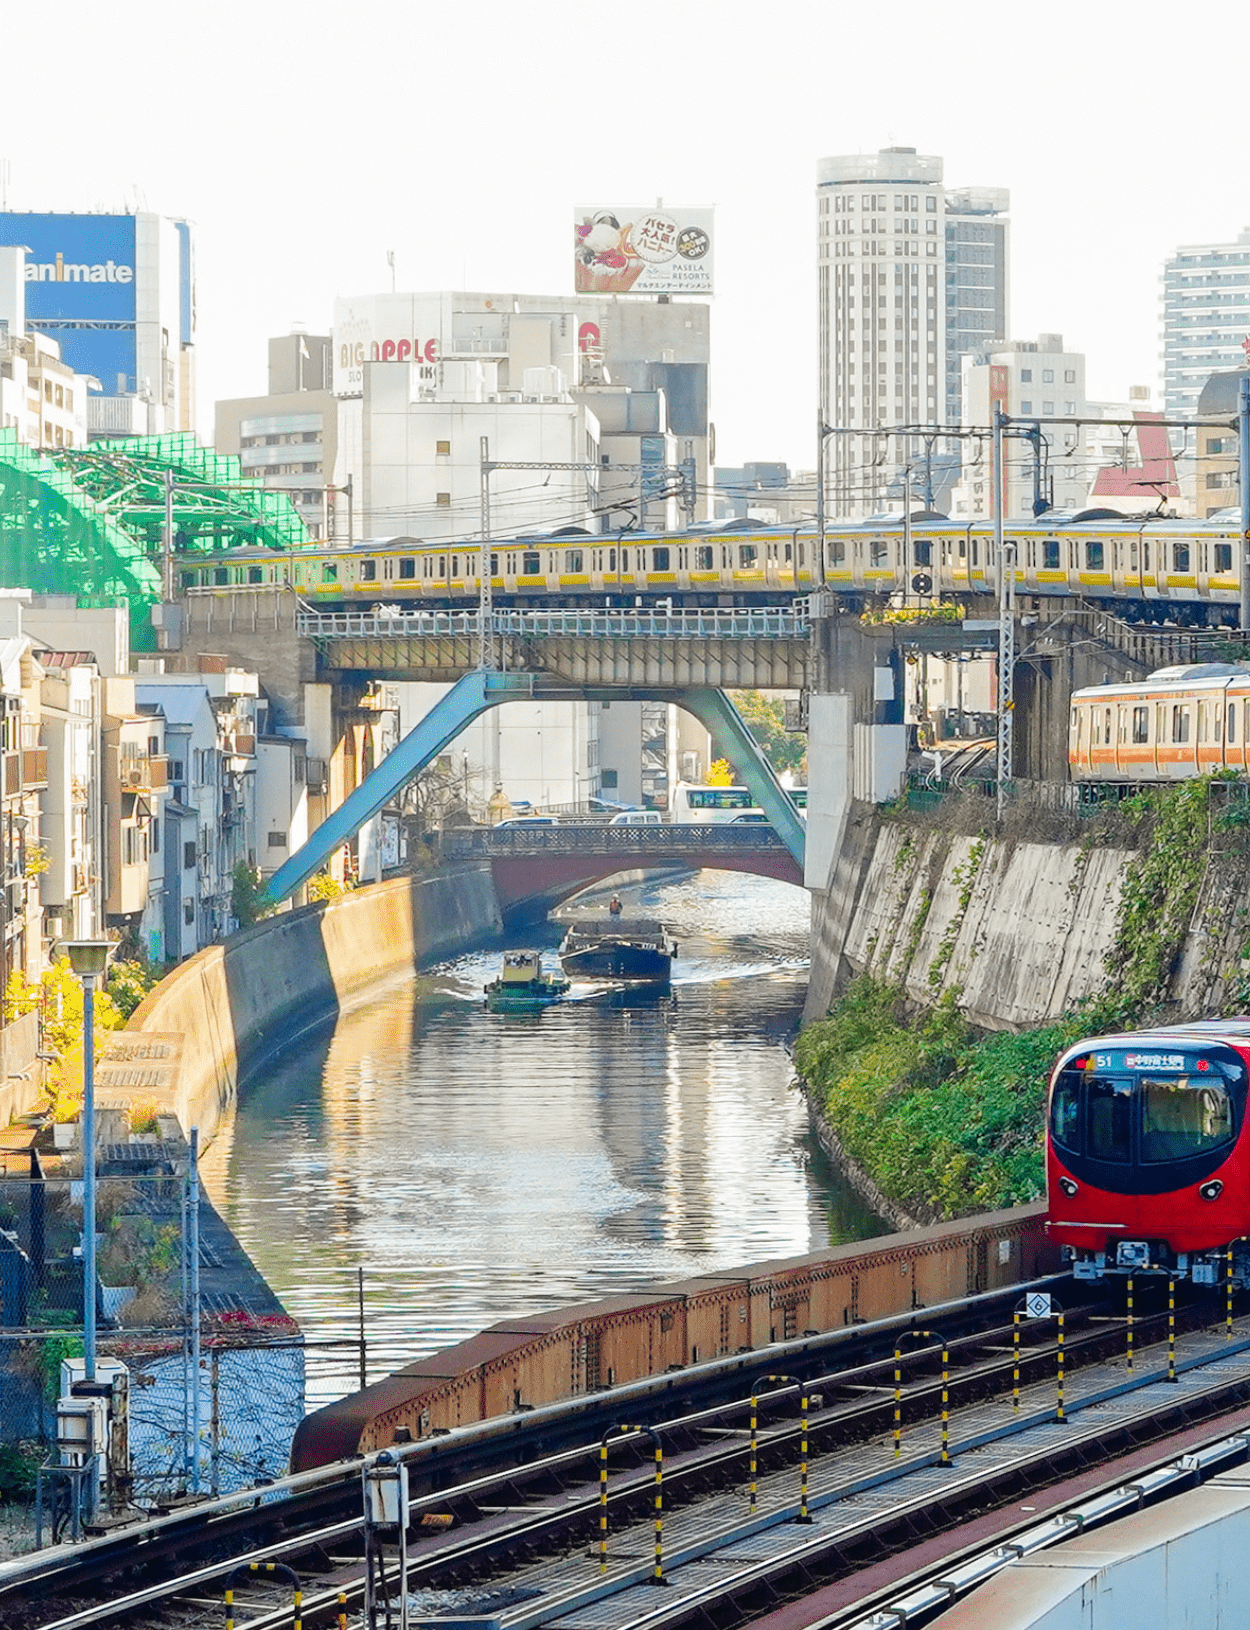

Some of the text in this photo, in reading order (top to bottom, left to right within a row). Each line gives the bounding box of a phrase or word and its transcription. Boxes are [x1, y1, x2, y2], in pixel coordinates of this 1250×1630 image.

[25, 252, 133, 283] animate
[340, 338, 440, 369] BIG APPLE
[1097, 1056, 1111, 1067] 51
[1034, 1300, 1043, 1311] 6
[1187, 1457, 1194, 1468] 7
